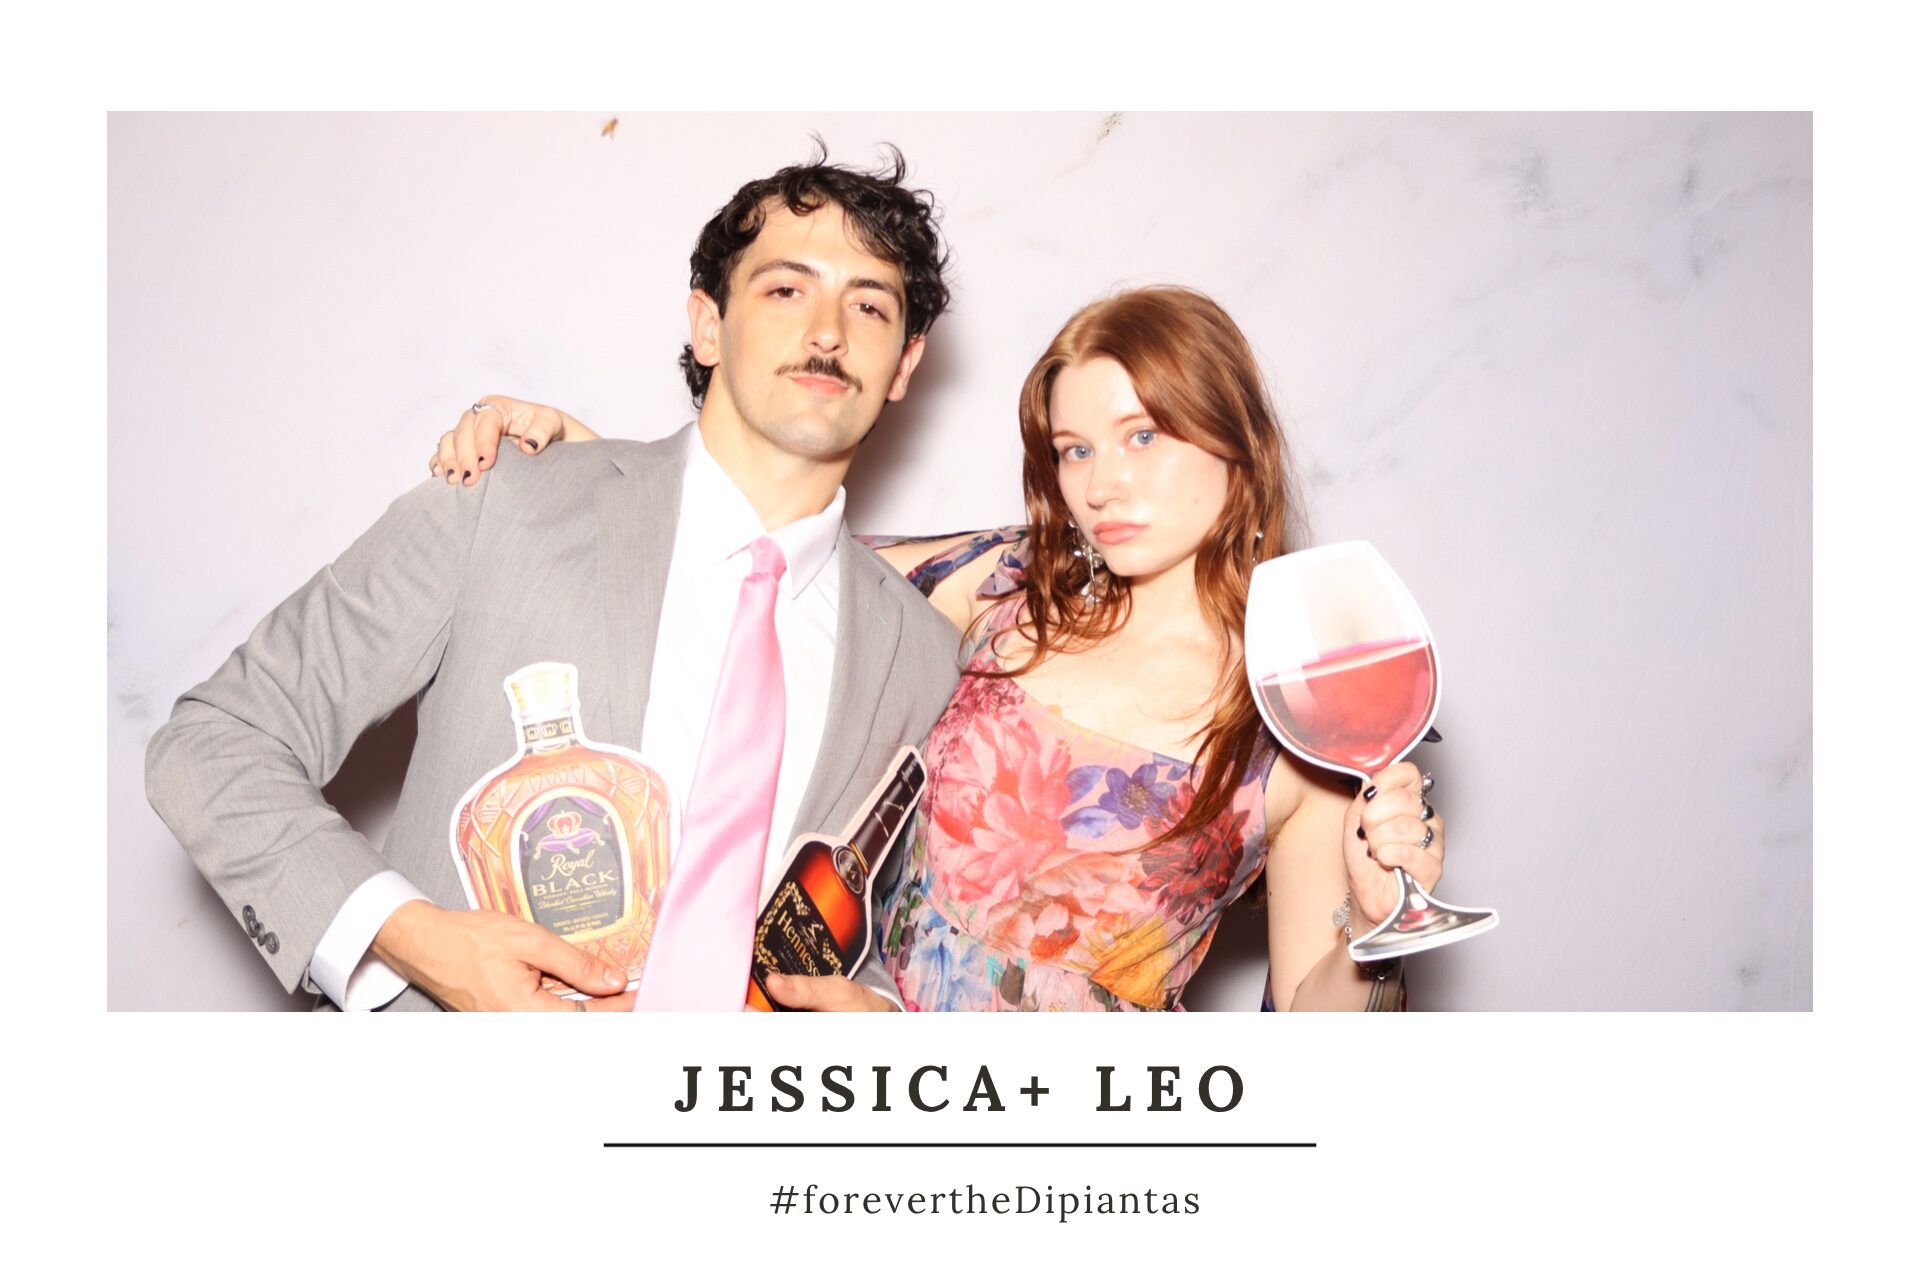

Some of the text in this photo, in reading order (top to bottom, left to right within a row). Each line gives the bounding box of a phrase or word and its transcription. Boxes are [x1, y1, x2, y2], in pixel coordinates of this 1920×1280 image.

[541, 849, 595, 880] Royal
[532, 869, 616, 896] BLACK
[777, 910, 821, 976] Henness
